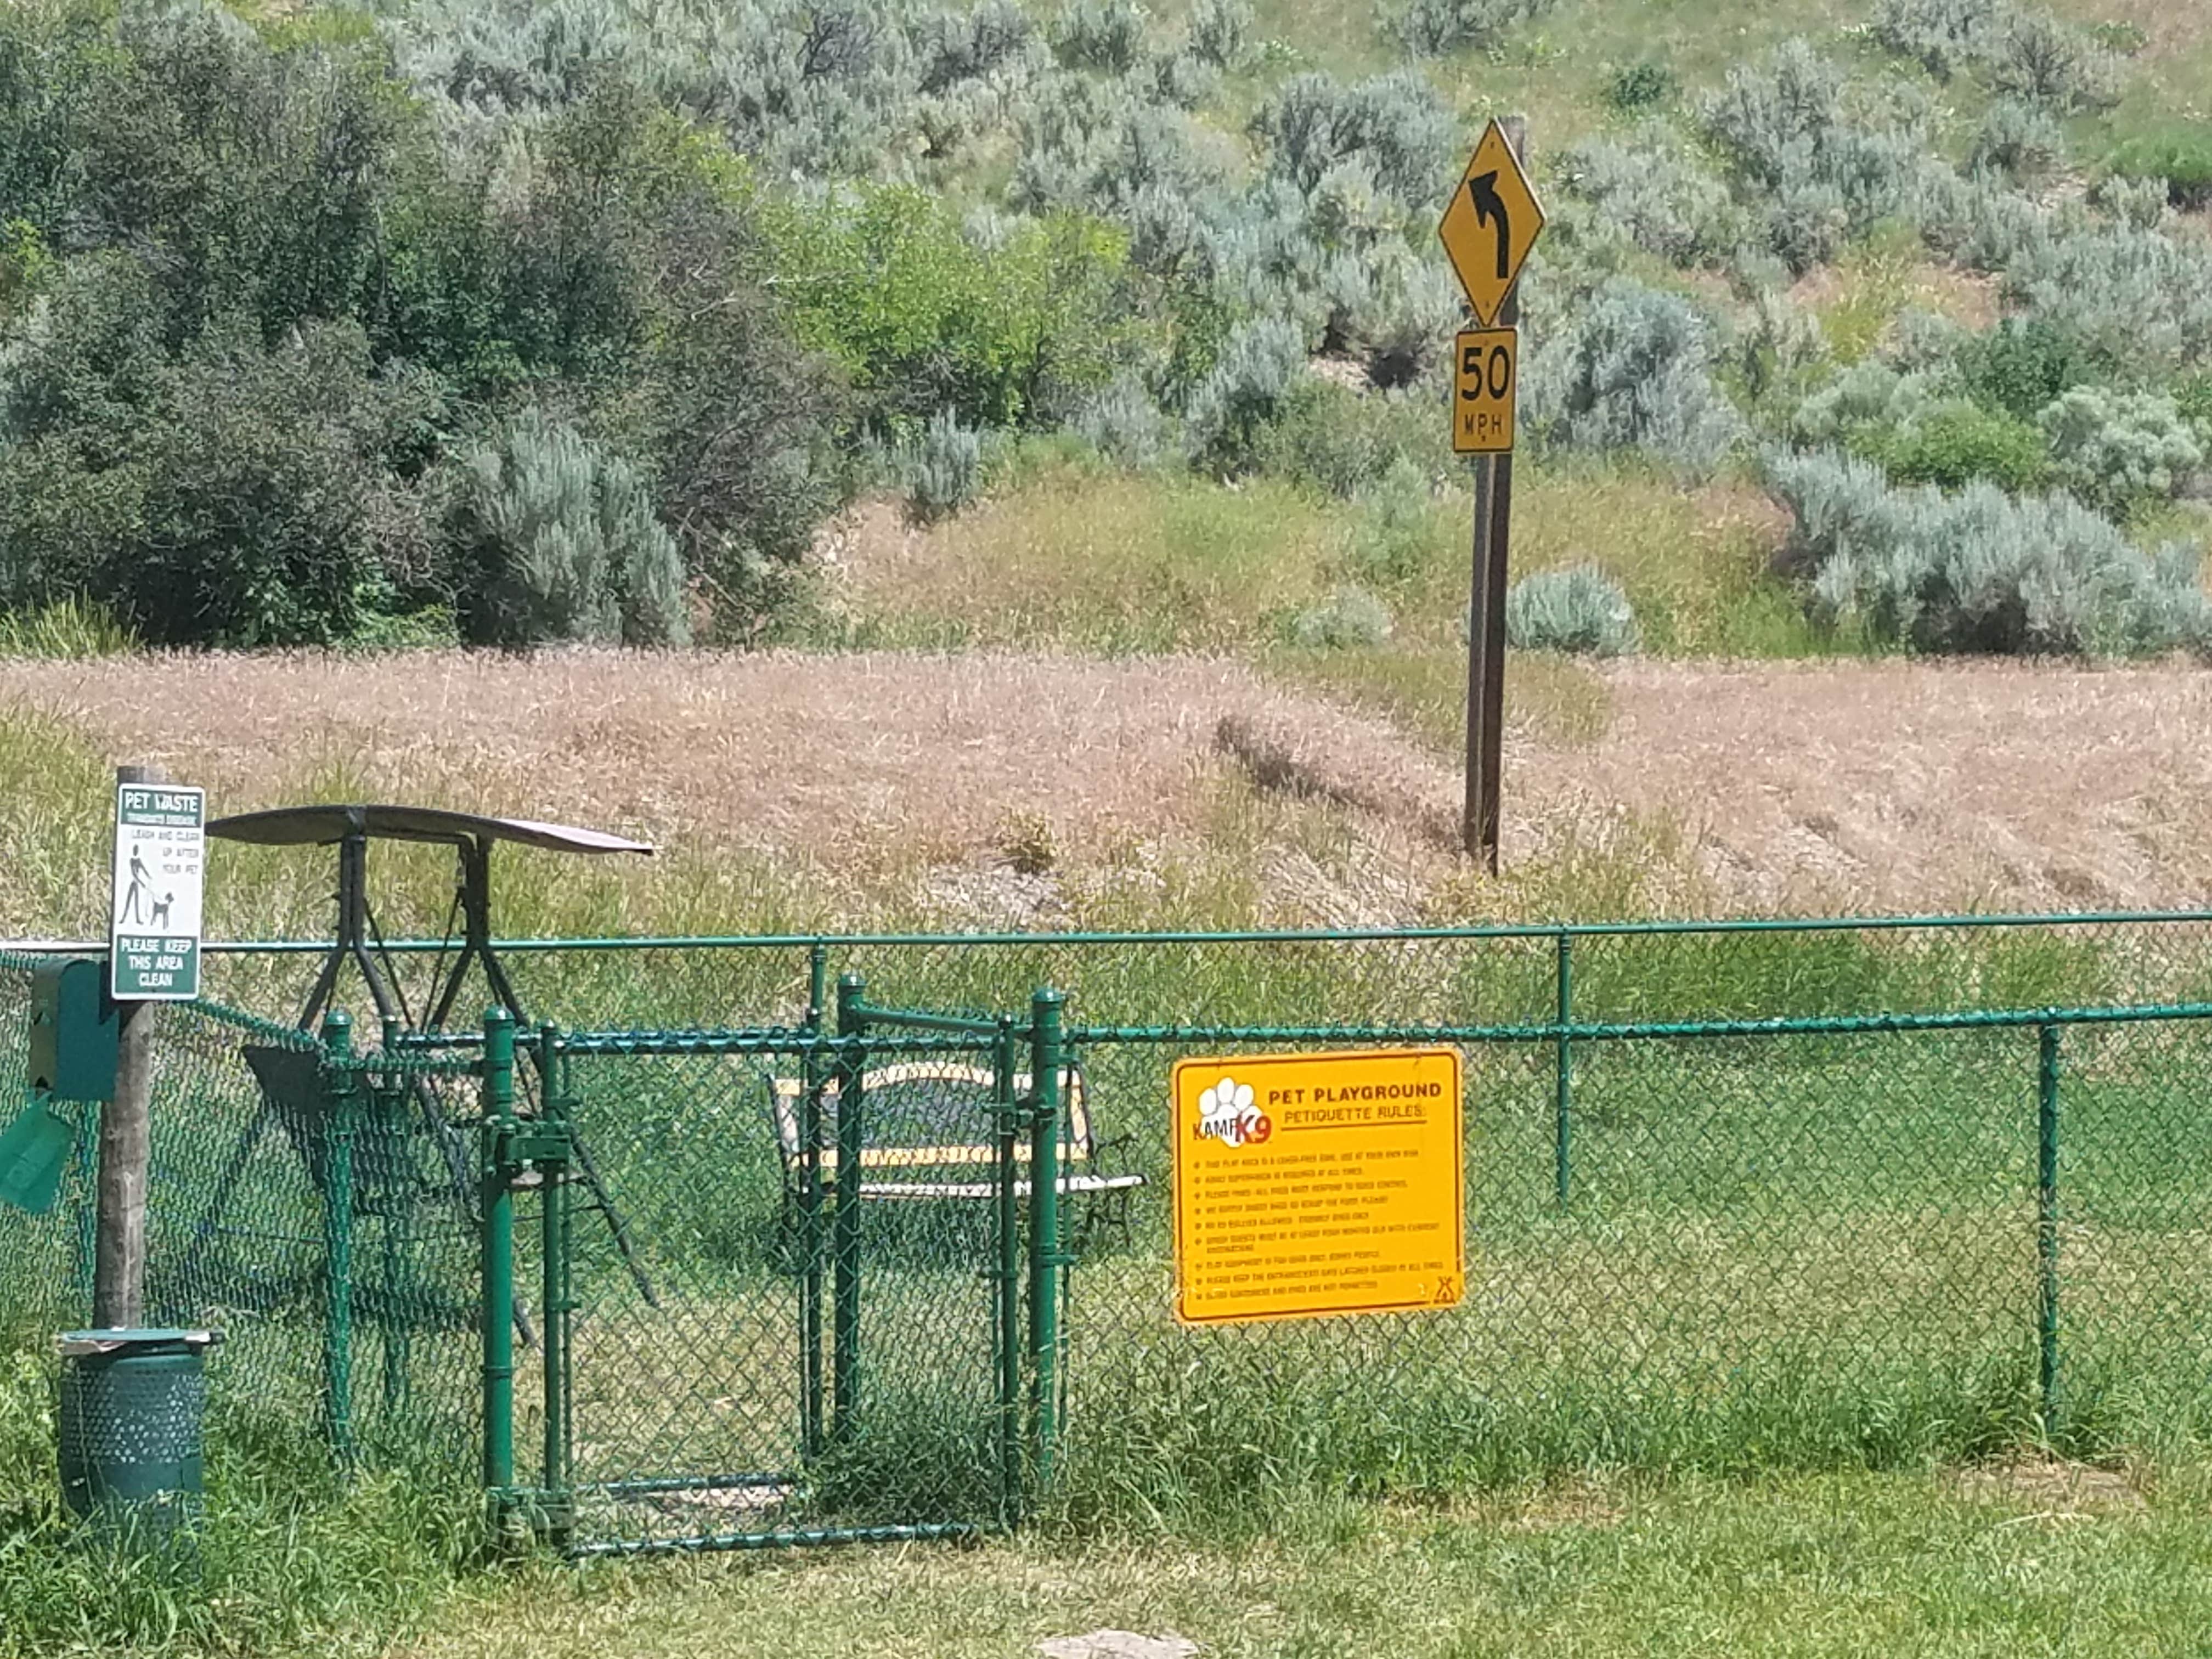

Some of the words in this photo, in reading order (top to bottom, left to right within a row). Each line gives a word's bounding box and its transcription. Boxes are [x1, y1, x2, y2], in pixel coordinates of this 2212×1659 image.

[1462, 345, 1510, 400] 50
[1464, 414, 1502, 435] MPH
[126, 792, 151, 809] PET
[154, 793, 198, 812] WASTE
[121, 938, 160, 952] PLEASE
[165, 939, 192, 953] KEEP
[128, 956, 151, 969] THIS
[155, 956, 183, 970] AREA
[139, 973, 172, 986] CLEAN
[1269, 1088, 1305, 1105] PET
[1314, 1082, 1441, 1102] PLAYGROUND
[1284, 1107, 1372, 1124] PETIQUETTE
[1235, 1111, 1272, 1143] K9
